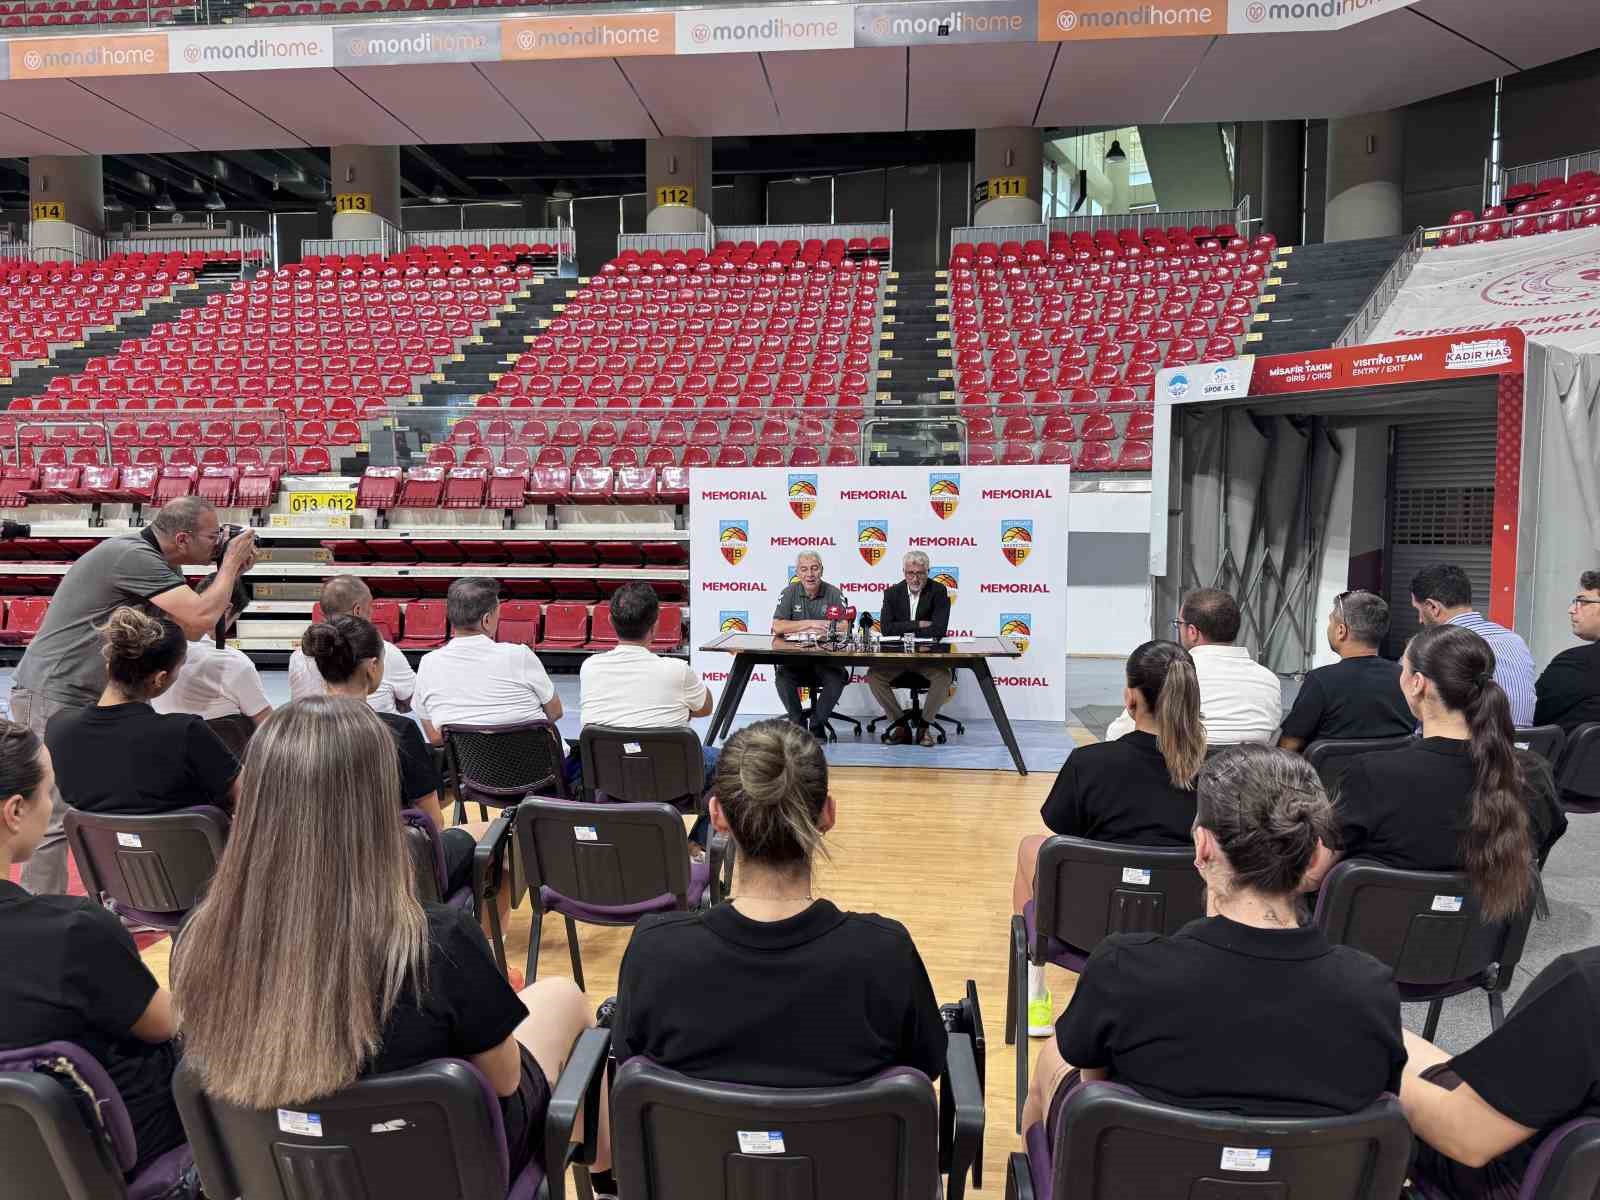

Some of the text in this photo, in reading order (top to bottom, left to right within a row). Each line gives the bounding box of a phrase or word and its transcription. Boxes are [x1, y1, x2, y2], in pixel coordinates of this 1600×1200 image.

[893, 12, 1023, 33] mondihome
[1079, 5, 1212, 27] mondihome
[713, 17, 838, 40] mondihome
[539, 25, 659, 46] mondihome
[203, 40, 319, 59] mondihome
[368, 32, 488, 54] mondihome
[44, 48, 155, 67] mondihome
[994, 180, 1019, 194] 111
[661, 190, 689, 203] 112
[340, 197, 365, 210] 113
[35, 205, 59, 218] 114
[1485, 346, 1511, 358] HAS
[1352, 353, 1423, 368] VISITING TEAM
[1305, 363, 1333, 373] TAKIM
[1352, 366, 1380, 376] ENTRY
[1386, 363, 1405, 373] EXIT
[702, 490, 767, 500] MEMORIAL
[840, 490, 907, 500] MEMORIAL
[982, 489, 1053, 499] MEMORIAL
[293, 498, 354, 512] 013 012
[770, 536, 837, 546] MEMORIAL
[909, 536, 978, 547] MEMORIAL
[702, 582, 767, 592] MEMORIAL
[980, 583, 1050, 593] MEMORIAL
[992, 676, 1049, 687] EMORIAL
